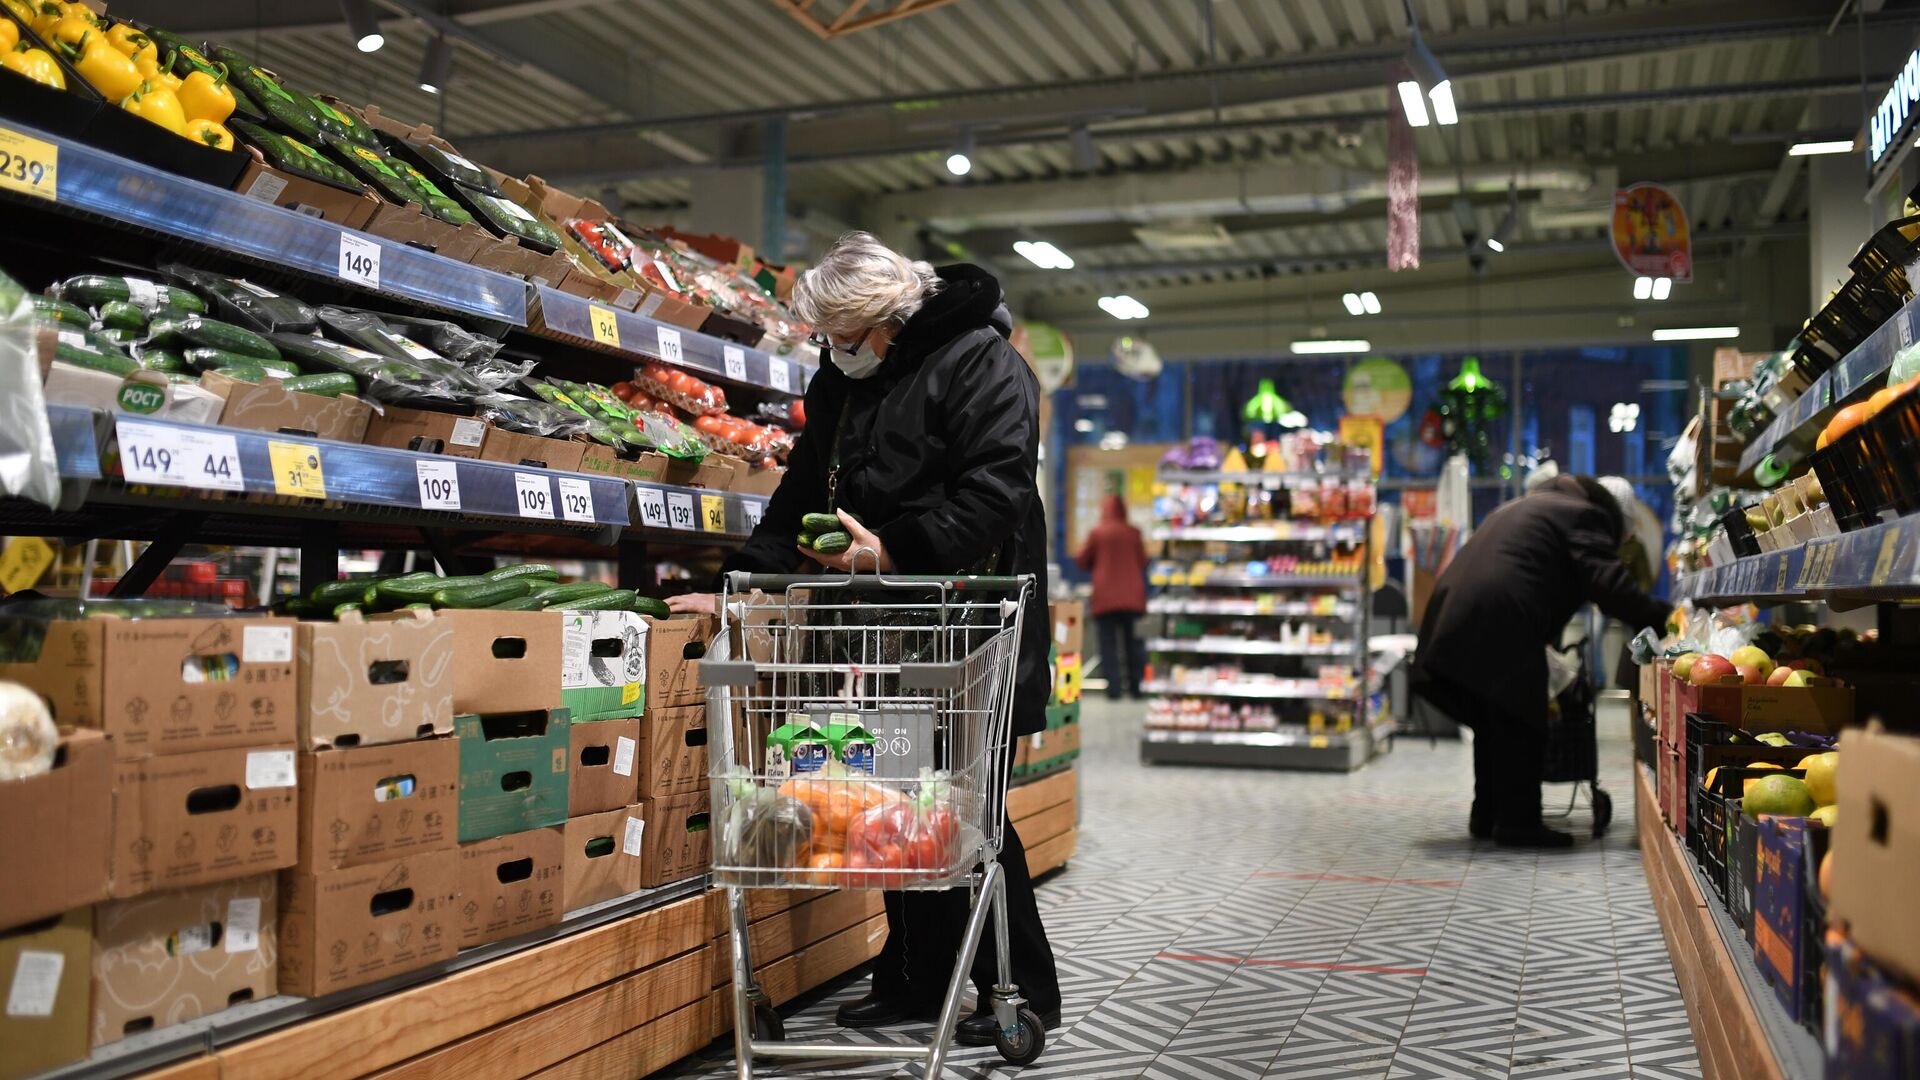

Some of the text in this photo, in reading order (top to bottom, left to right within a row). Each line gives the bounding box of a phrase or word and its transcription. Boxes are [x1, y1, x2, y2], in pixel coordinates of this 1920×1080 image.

[0, 150, 44, 186] 239
[345, 251, 372, 277] 149
[600, 321, 614, 339] 94
[663, 340, 678, 358] 119
[122, 388, 161, 407] РОСТ
[128, 445, 171, 473] 149
[203, 453, 232, 479] 44
[288, 470, 303, 487] 31
[423, 478, 451, 500] 109
[520, 489, 545, 510] 109
[565, 494, 587, 514] 129
[643, 502, 661, 520] 149
[672, 505, 689, 523] 139
[709, 510, 721, 525] 94
